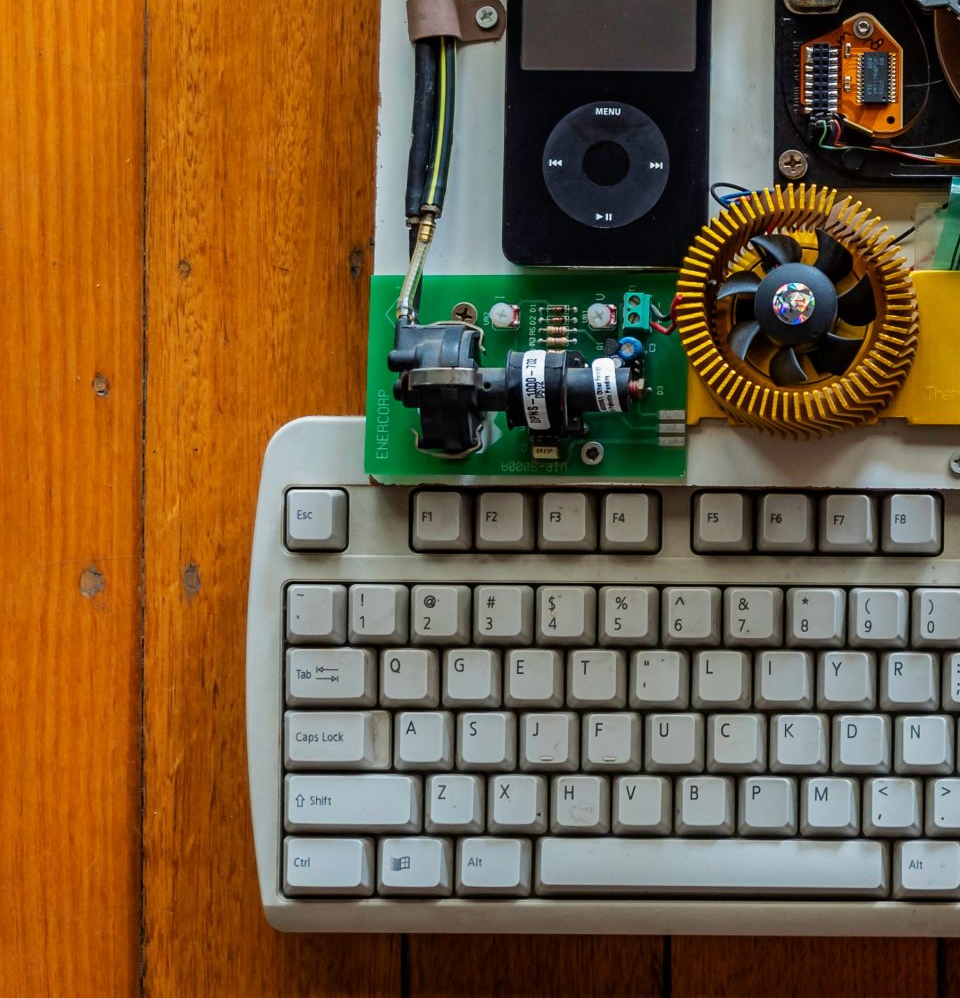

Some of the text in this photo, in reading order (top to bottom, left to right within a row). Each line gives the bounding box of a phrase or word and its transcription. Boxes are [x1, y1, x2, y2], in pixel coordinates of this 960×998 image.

[595, 107, 621, 116] MENU
[376, 389, 393, 459] ENERCORP
[297, 510, 312, 519] Esc
[422, 512, 432, 521] F1
[486, 512, 497, 521] F2
[550, 512, 561, 522] F3
[613, 513, 625, 523] F4
[708, 513, 718, 522] F5
[771, 514, 782, 523] F6
[834, 515, 844, 525] F7
[895, 514, 906, 524] F8
[360, 616, 364, 628] 1
[424, 617, 430, 629] 2
[486, 617, 492, 630] 3
[549, 617, 556, 630] 4
[614, 618, 621, 630] 5
[675, 619, 682, 631] 6
[738, 619, 746, 632] 7
[801, 619, 808, 632] 8
[865, 620, 872, 632] 9
[927, 621, 934, 633] 0
[390, 658, 400, 673] Q
[454, 658, 464, 672] G
[517, 660, 524, 674] E
[581, 661, 590, 674] T
[706, 660, 713, 674] L
[769, 661, 771, 675] I
[832, 662, 841, 676] Y
[895, 662, 903, 676] R
[296, 670, 311, 679] Tab
[406, 721, 416, 734] A
[470, 722, 477, 736] S
[533, 722, 538, 736] J
[595, 723, 603, 737] F
[660, 723, 668, 737] U
[721, 723, 730, 737] C
[785, 724, 793, 738] K
[848, 724, 857, 738] D
[911, 725, 920, 738] N
[296, 732, 343, 743] Caps Lock
[438, 785, 446, 799] Z
[500, 784, 510, 798] X
[565, 786, 574, 800] H
[626, 786, 636, 800] V
[690, 786, 698, 800] B
[752, 786, 760, 800] P
[815, 787, 828, 801] M
[310, 796, 331, 805] Shift
[294, 858, 310, 867] Ctrl
[468, 858, 482, 866] Alt
[909, 860, 922, 869] Alt
